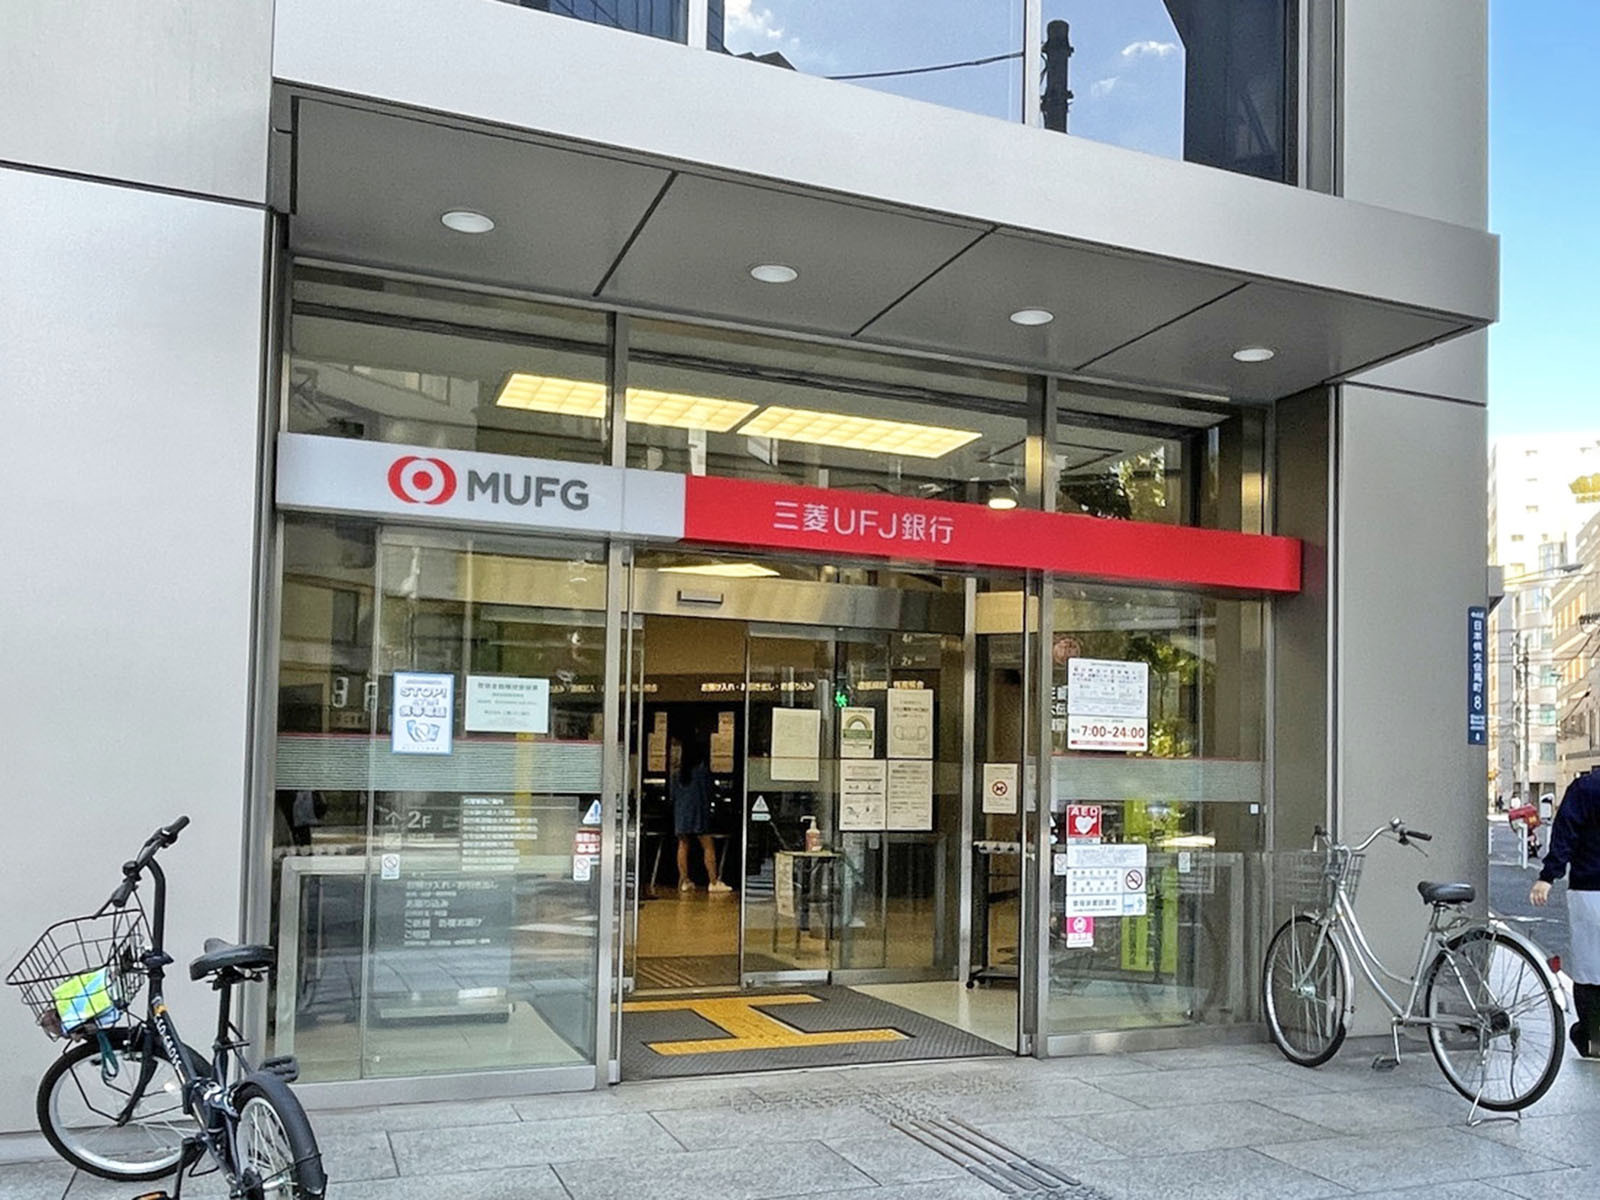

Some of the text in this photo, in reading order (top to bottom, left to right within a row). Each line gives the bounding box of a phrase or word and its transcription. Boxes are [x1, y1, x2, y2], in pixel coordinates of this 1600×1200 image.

[467, 470, 589, 511] MUFG
[773, 501, 954, 544] 三菱UFJ銀行
[1474, 695, 1482, 710] 8
[407, 810, 432, 829] 2F
[1071, 807, 1098, 817] AED
